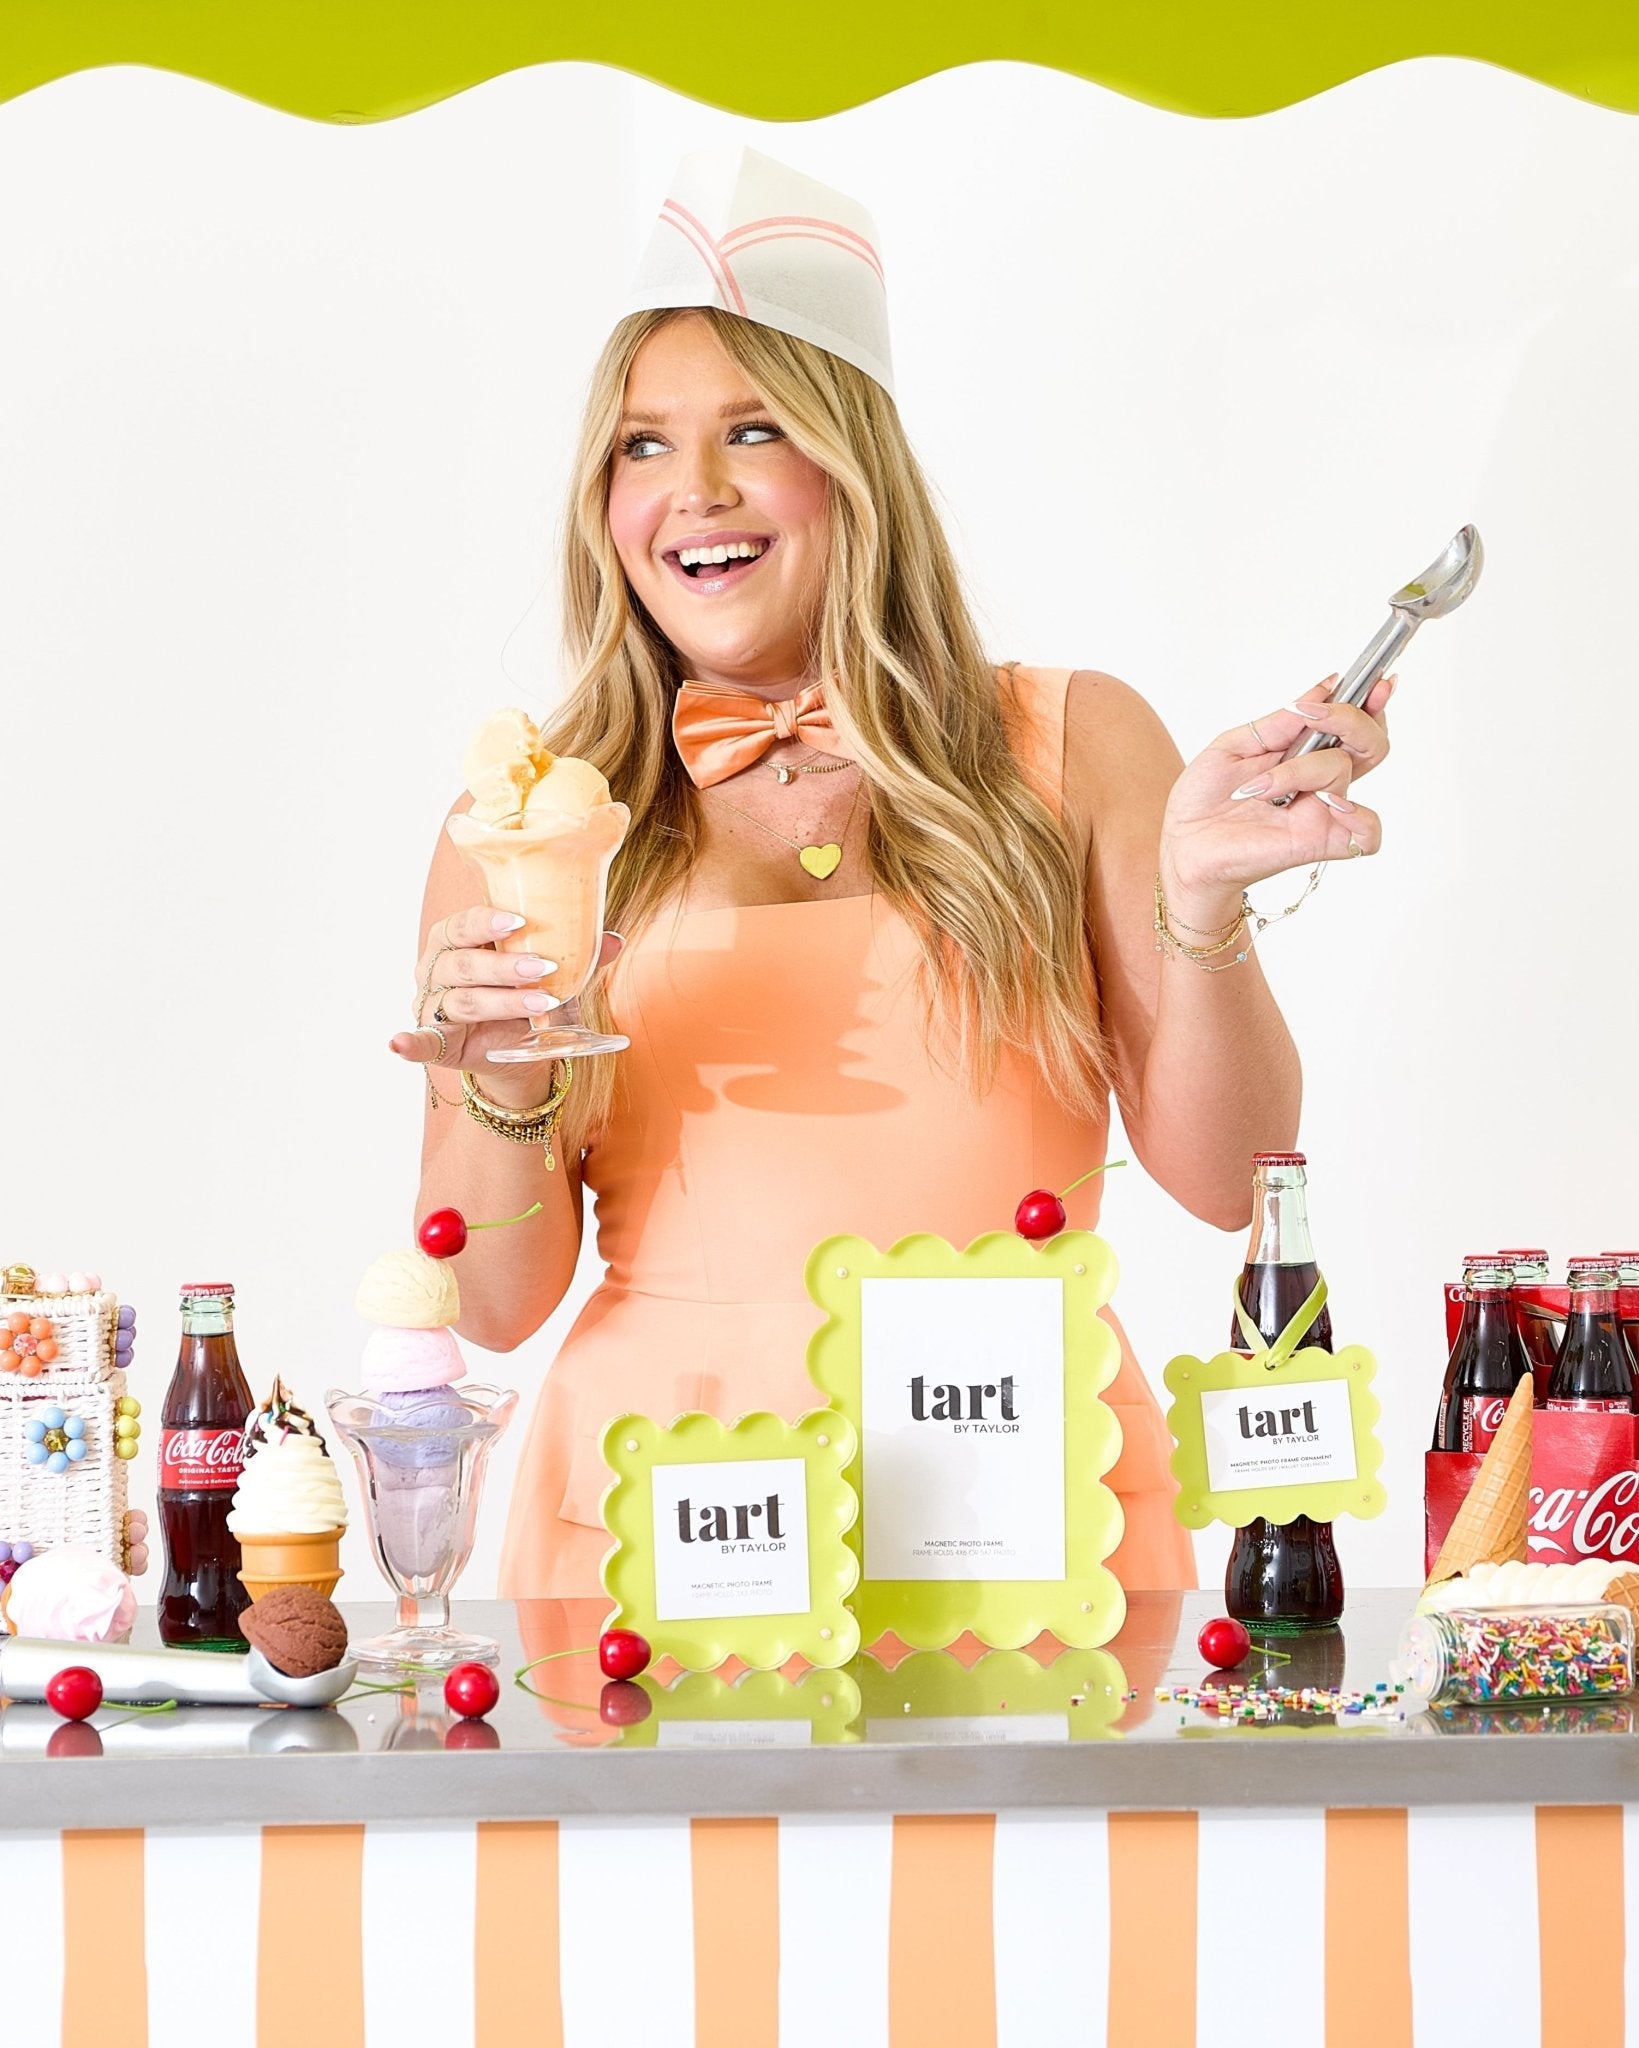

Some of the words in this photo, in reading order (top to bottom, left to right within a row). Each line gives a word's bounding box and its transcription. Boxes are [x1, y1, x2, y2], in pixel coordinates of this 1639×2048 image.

[905, 1375, 1020, 1421] tart
[1463, 1398, 1470, 1413] ME
[1235, 1400, 1319, 1439] tart
[953, 1424, 970, 1434] BY
[972, 1424, 1020, 1434] TAYLOR
[1272, 1437, 1283, 1445] BY
[1286, 1434, 1319, 1444] TAYLOR
[164, 1430, 246, 1466] Coca-Col
[1230, 1460, 1258, 1468] MAGNETIC
[1260, 1458, 1280, 1466] PHOTO
[673, 1493, 786, 1543] tart
[721, 1544, 737, 1554] BY
[740, 1542, 787, 1553] TAYLOR
[691, 1581, 725, 1590] MAGNETIC
[727, 1580, 750, 1588] PHOTO
[751, 1579, 773, 1587] FRAME
